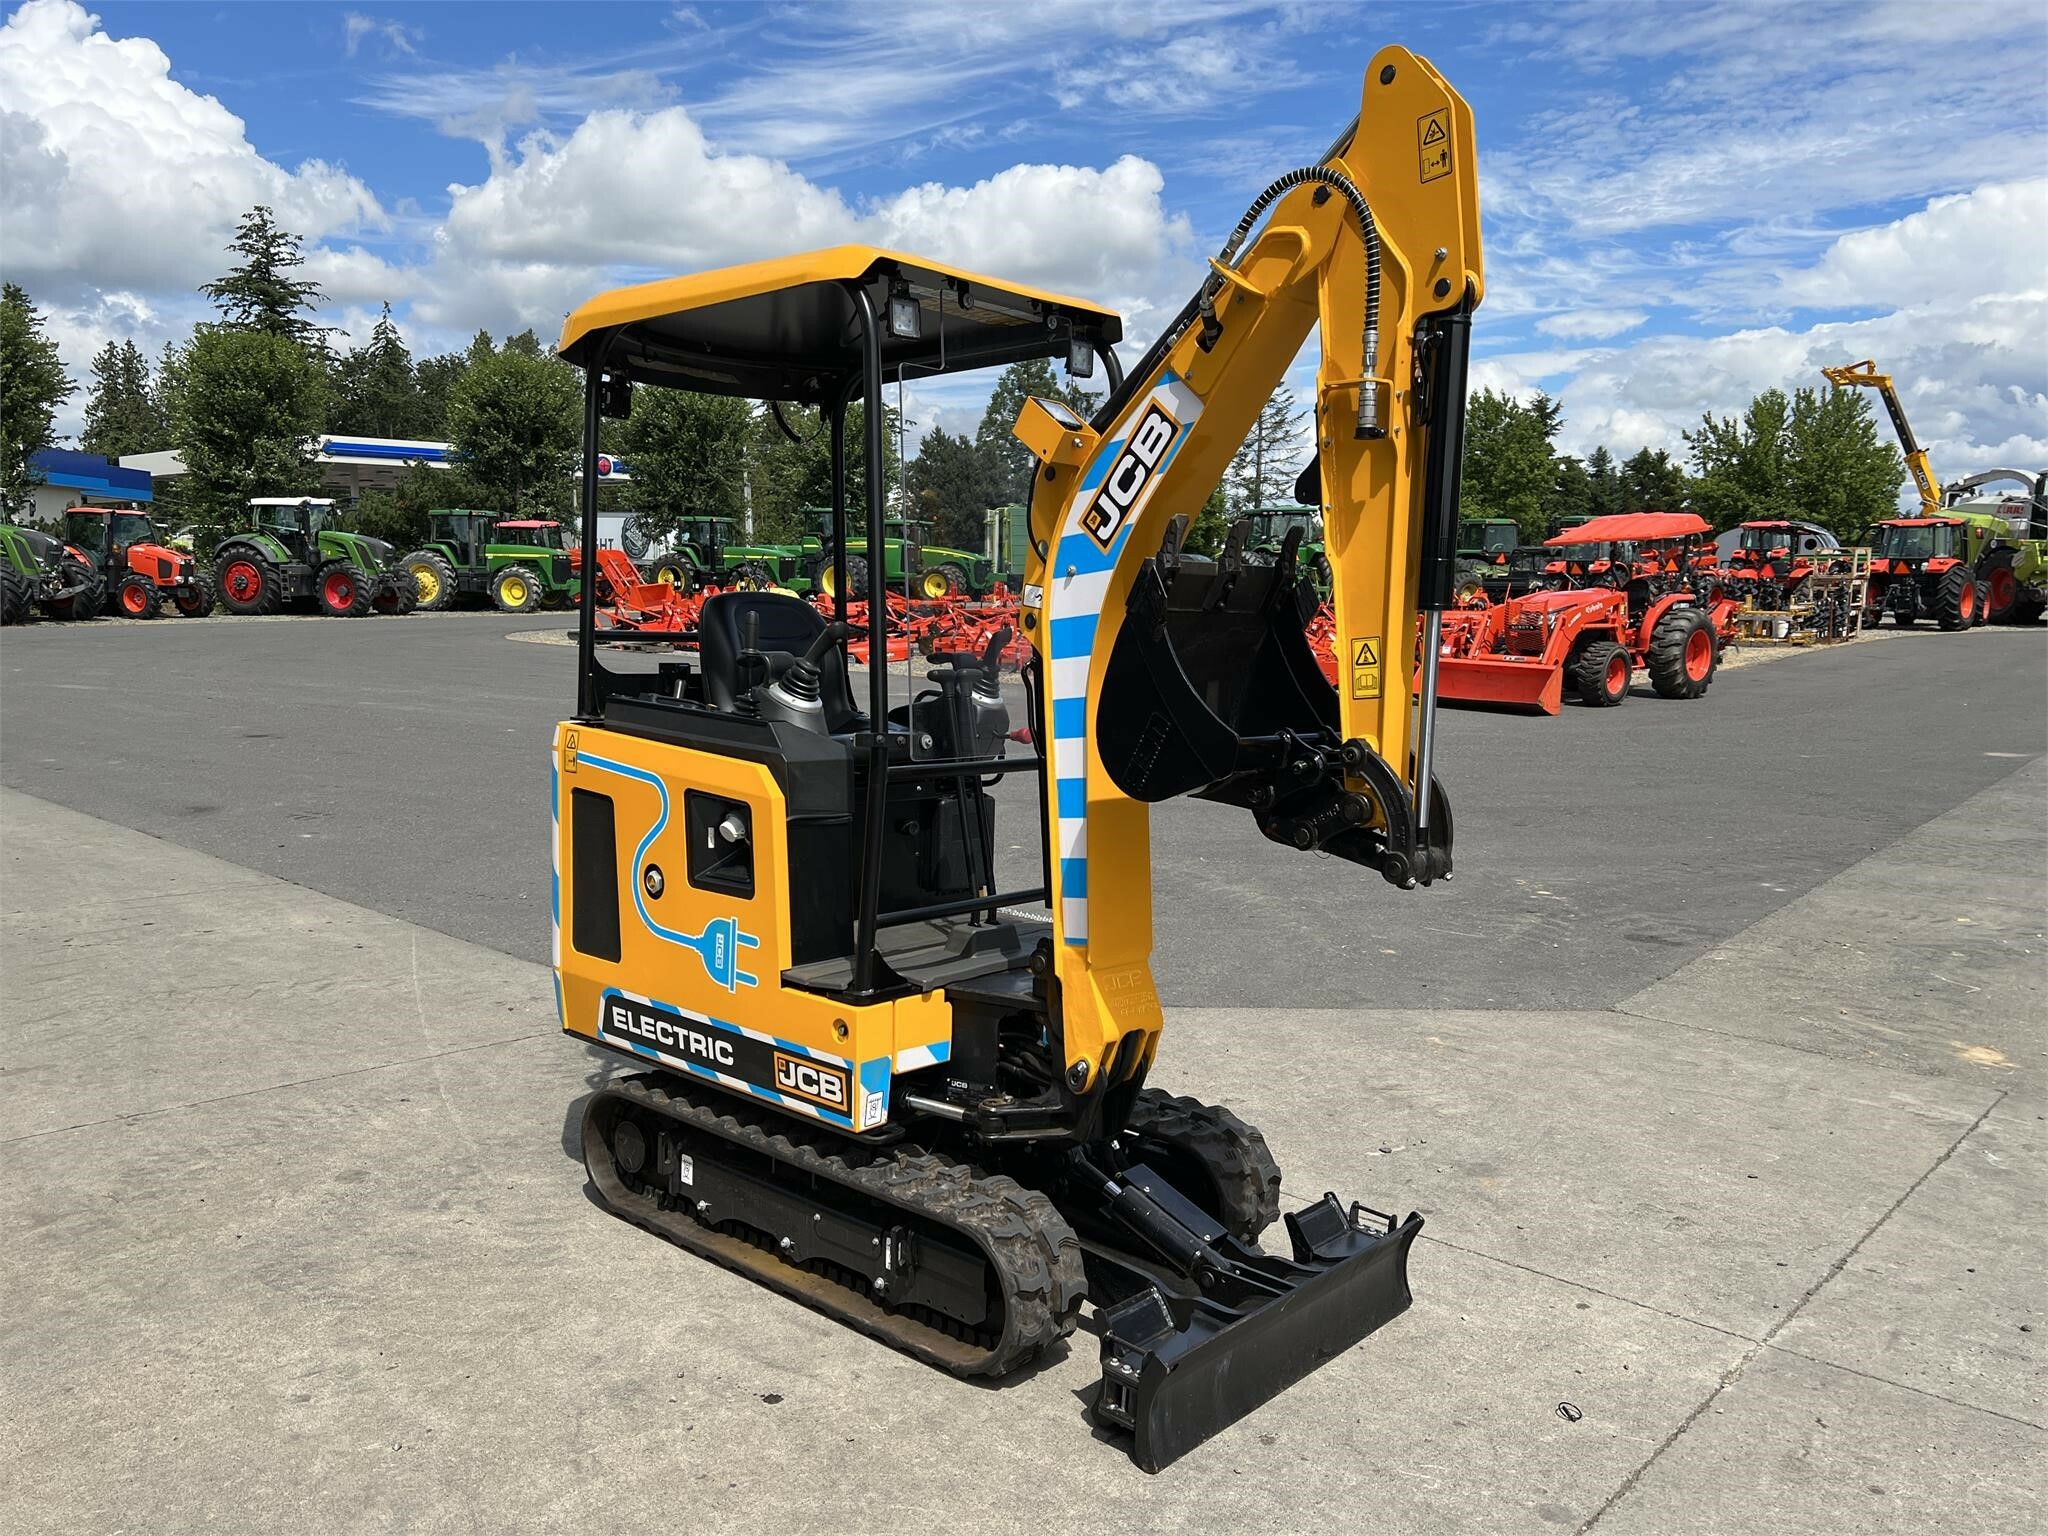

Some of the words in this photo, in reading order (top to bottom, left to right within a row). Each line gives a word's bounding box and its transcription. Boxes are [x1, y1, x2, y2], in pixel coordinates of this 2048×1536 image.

[1097, 412, 1172, 540] JCB
[1916, 468, 1929, 490] JCB
[1996, 504, 2025, 514] CLAAS
[612, 1006, 734, 1066] ELECTRIC
[778, 1062, 843, 1103] JCB
[951, 1080, 968, 1089] JCB
